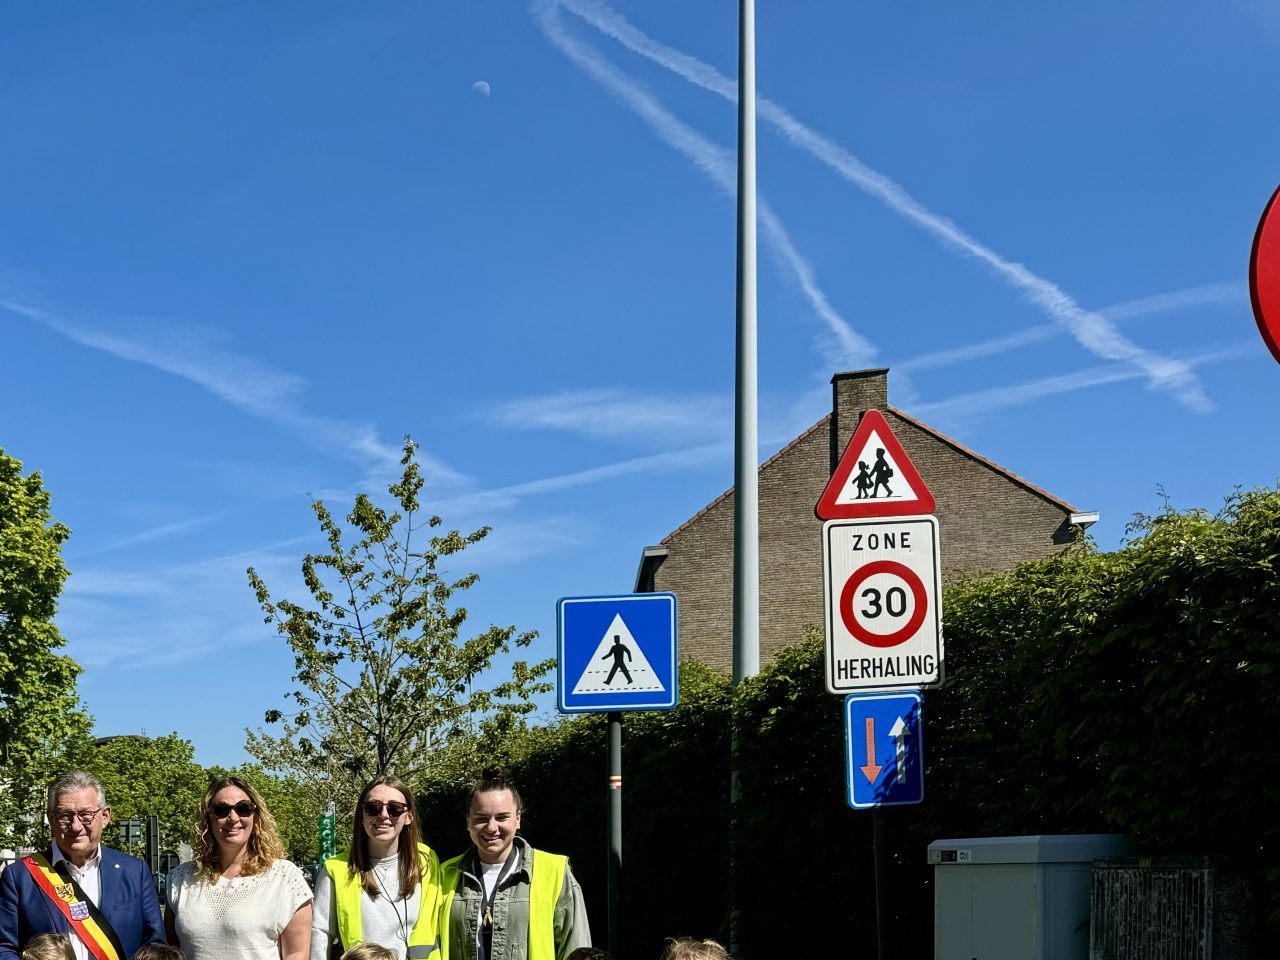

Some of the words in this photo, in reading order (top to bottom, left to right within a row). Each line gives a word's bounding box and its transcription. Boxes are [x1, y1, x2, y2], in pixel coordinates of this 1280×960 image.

[852, 531, 911, 551] ZONE
[861, 586, 907, 619] 30
[837, 654, 934, 680] HERHALING
